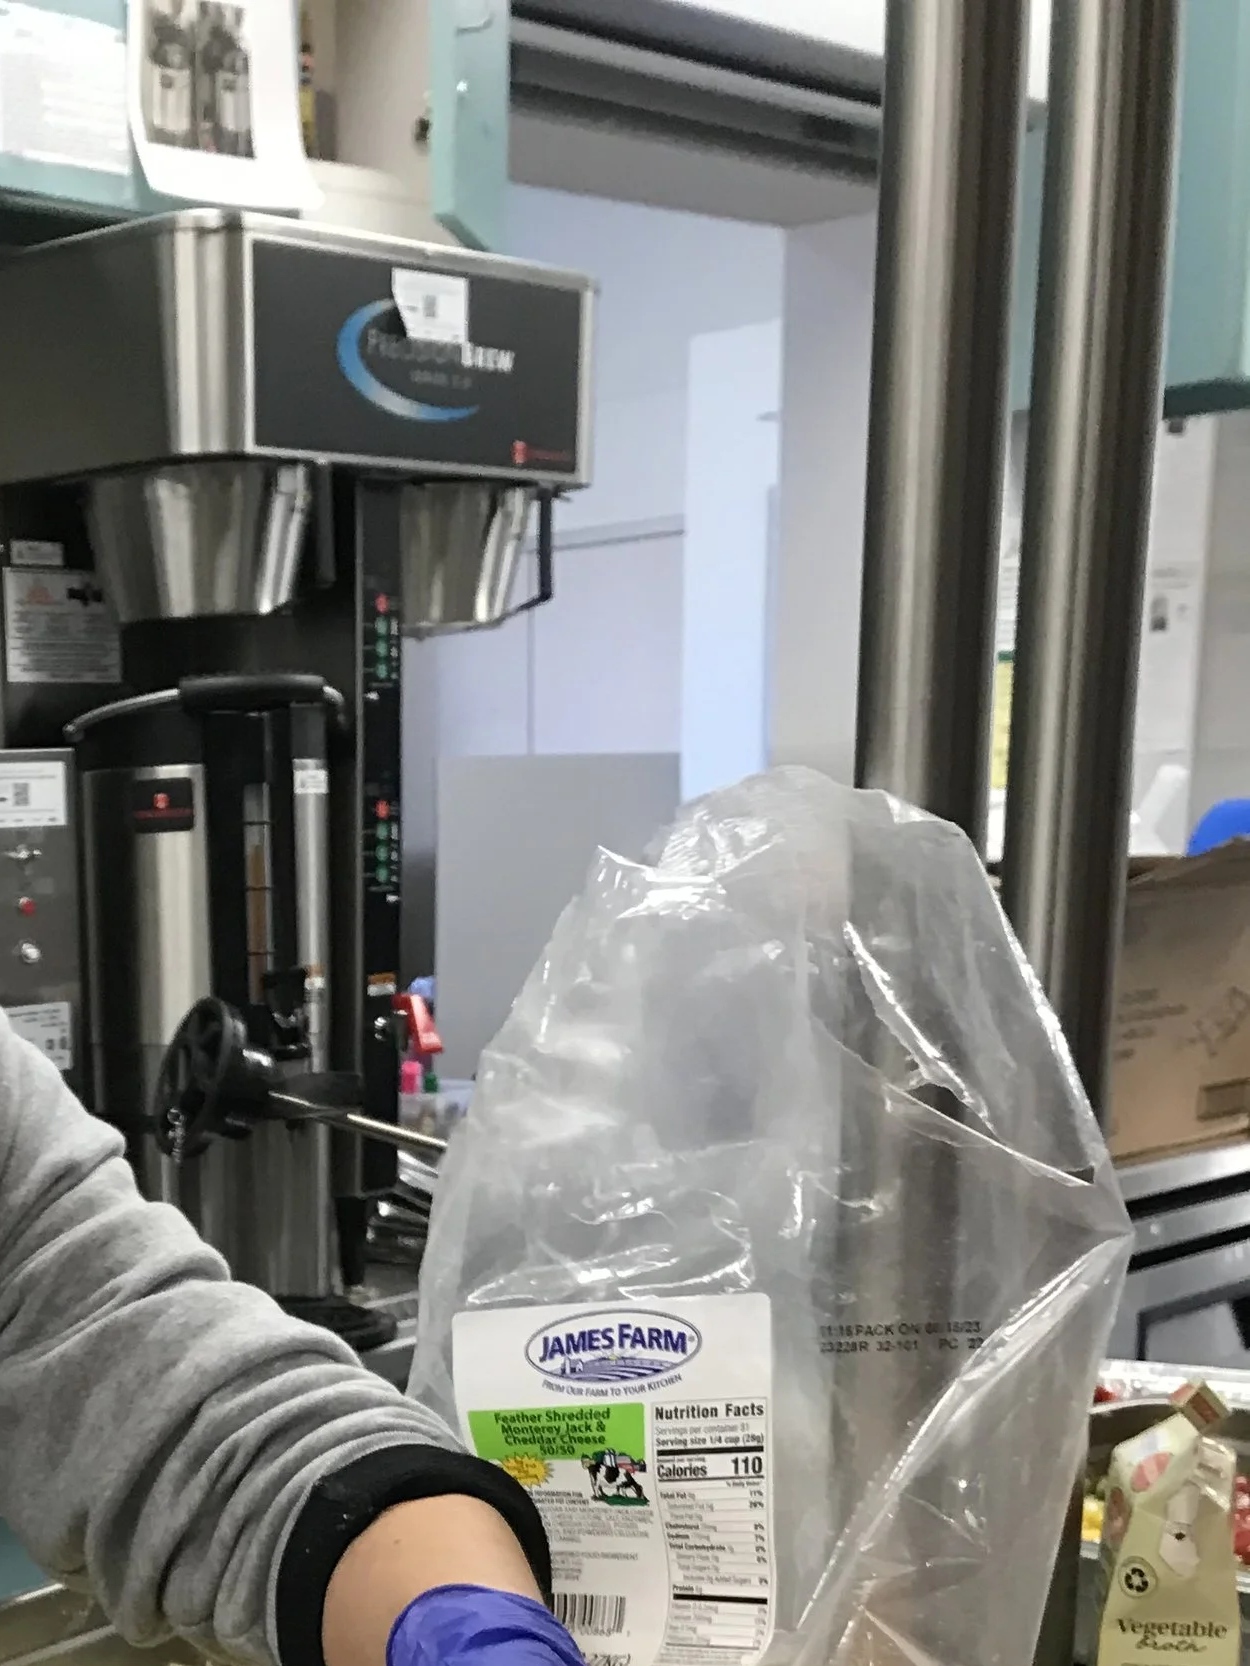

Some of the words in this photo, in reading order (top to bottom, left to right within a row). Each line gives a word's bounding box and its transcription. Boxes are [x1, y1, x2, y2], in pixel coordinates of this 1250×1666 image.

[539, 1327, 615, 1362] JAMES
[617, 1323, 688, 1354] FARM
[566, 1385, 584, 1396] OUR
[585, 1387, 608, 1397] FARM
[610, 1386, 622, 1397] TO
[622, 1382, 647, 1396] YOUR
[648, 1374, 683, 1392] KITCHEN
[494, 1411, 542, 1425] Feather
[545, 1407, 611, 1422] Shredded
[655, 1404, 719, 1420] Nutrition
[725, 1402, 764, 1418] Facts
[501, 1424, 561, 1436] Monterey
[566, 1421, 591, 1434] Jack
[595, 1421, 606, 1433] &
[505, 1433, 557, 1446] Cheddar
[559, 1432, 606, 1445] Cheese
[655, 1437, 688, 1448] Serving
[657, 1463, 708, 1478] Calories
[731, 1456, 763, 1475] 110
[1116, 1617, 1228, 1639] Vegetable
